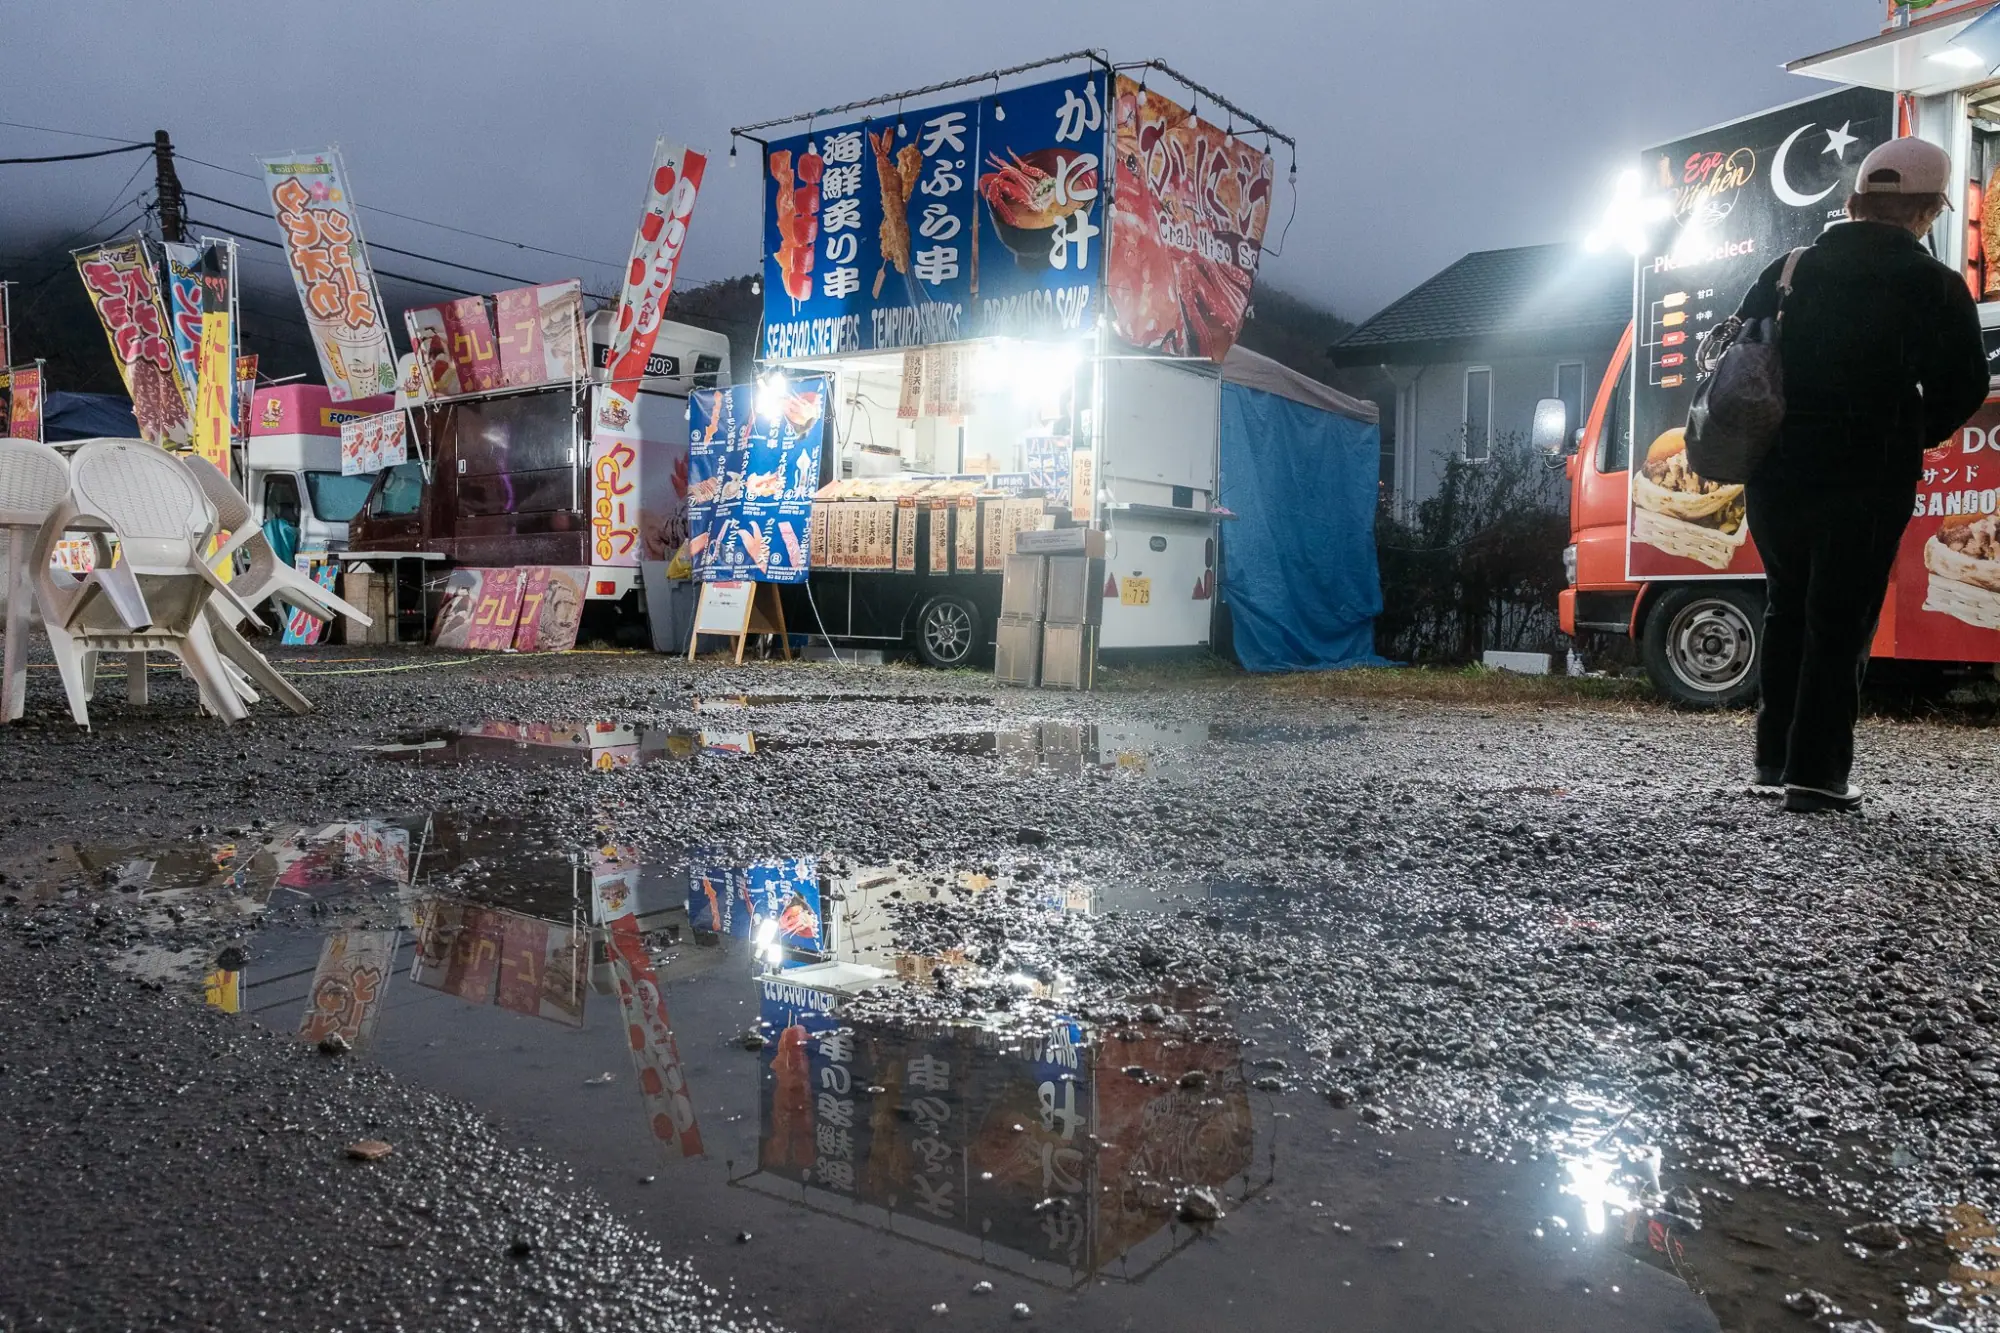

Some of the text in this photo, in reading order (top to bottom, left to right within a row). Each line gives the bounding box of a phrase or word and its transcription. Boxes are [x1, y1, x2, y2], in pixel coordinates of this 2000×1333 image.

[1048, 88, 1101, 271] かに汁
[1683, 151, 1723, 184] Ege
[822, 130, 863, 300] 海鮮炙り串
[914, 111, 967, 286] 天ぷら串
[1159, 214, 1193, 246] Crab
[1200, 230, 1232, 262] Miso
[1055, 284, 1090, 331] SOUP
[1695, 310, 1713, 320] 中辛
[1696, 288, 1714, 300] 甘口
[453, 317, 536, 364] クレープ
[766, 313, 861, 360] SEAFOOD SKEWERS
[871, 305, 921, 351] TEMPURA
[644, 355, 673, 375] HOP
[1922, 464, 1980, 485] サンド
[592, 455, 620, 562] Crepe
[608, 442, 639, 556] クレープ
